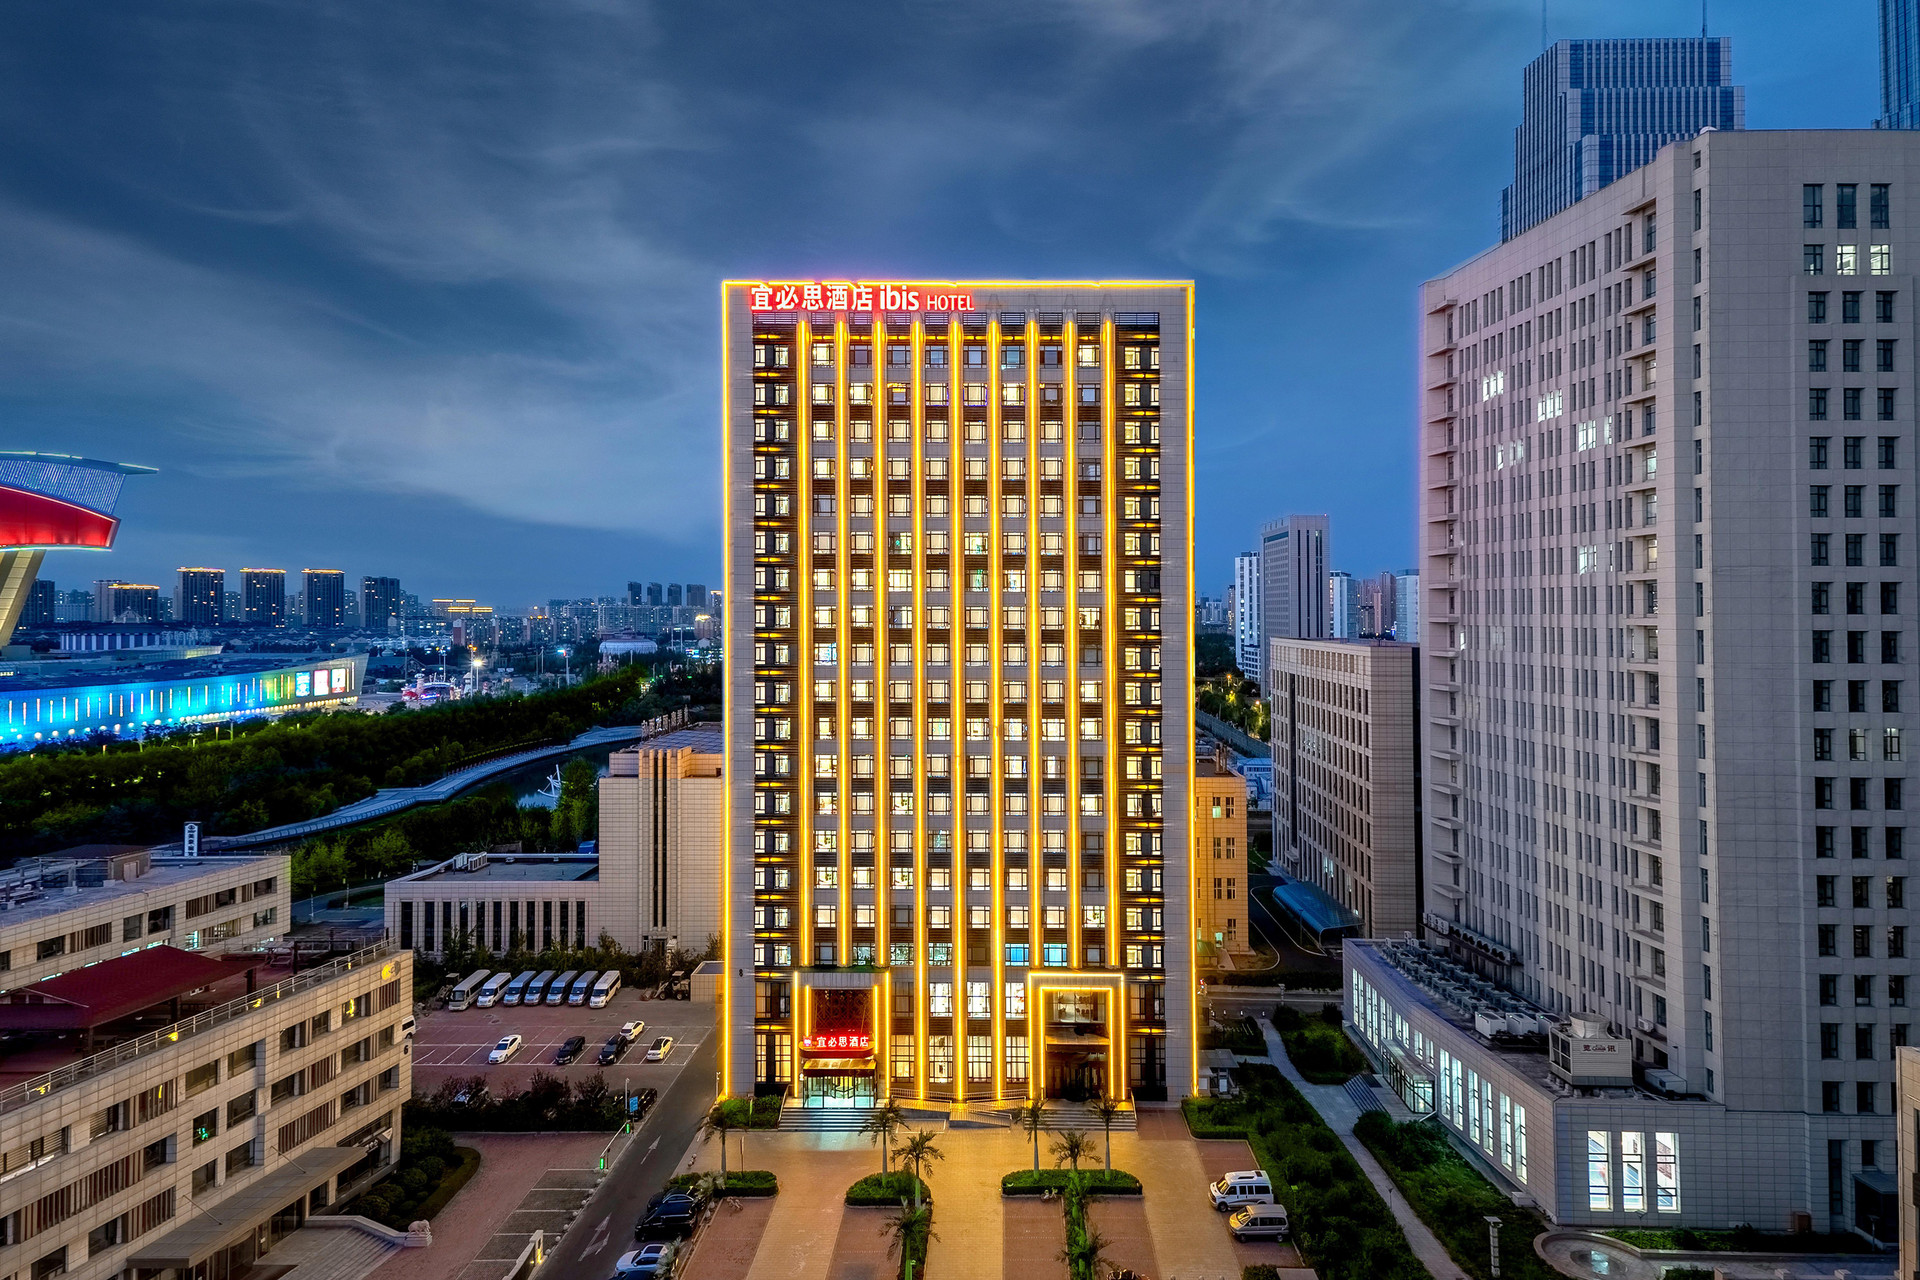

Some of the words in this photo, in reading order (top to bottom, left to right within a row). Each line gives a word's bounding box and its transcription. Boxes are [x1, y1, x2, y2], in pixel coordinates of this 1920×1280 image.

[751, 285, 873, 311] 宜必思酒店
[879, 285, 920, 311] ibis
[927, 295, 975, 311] HOTEL
[816, 1036, 869, 1048] 宜必思酒店
